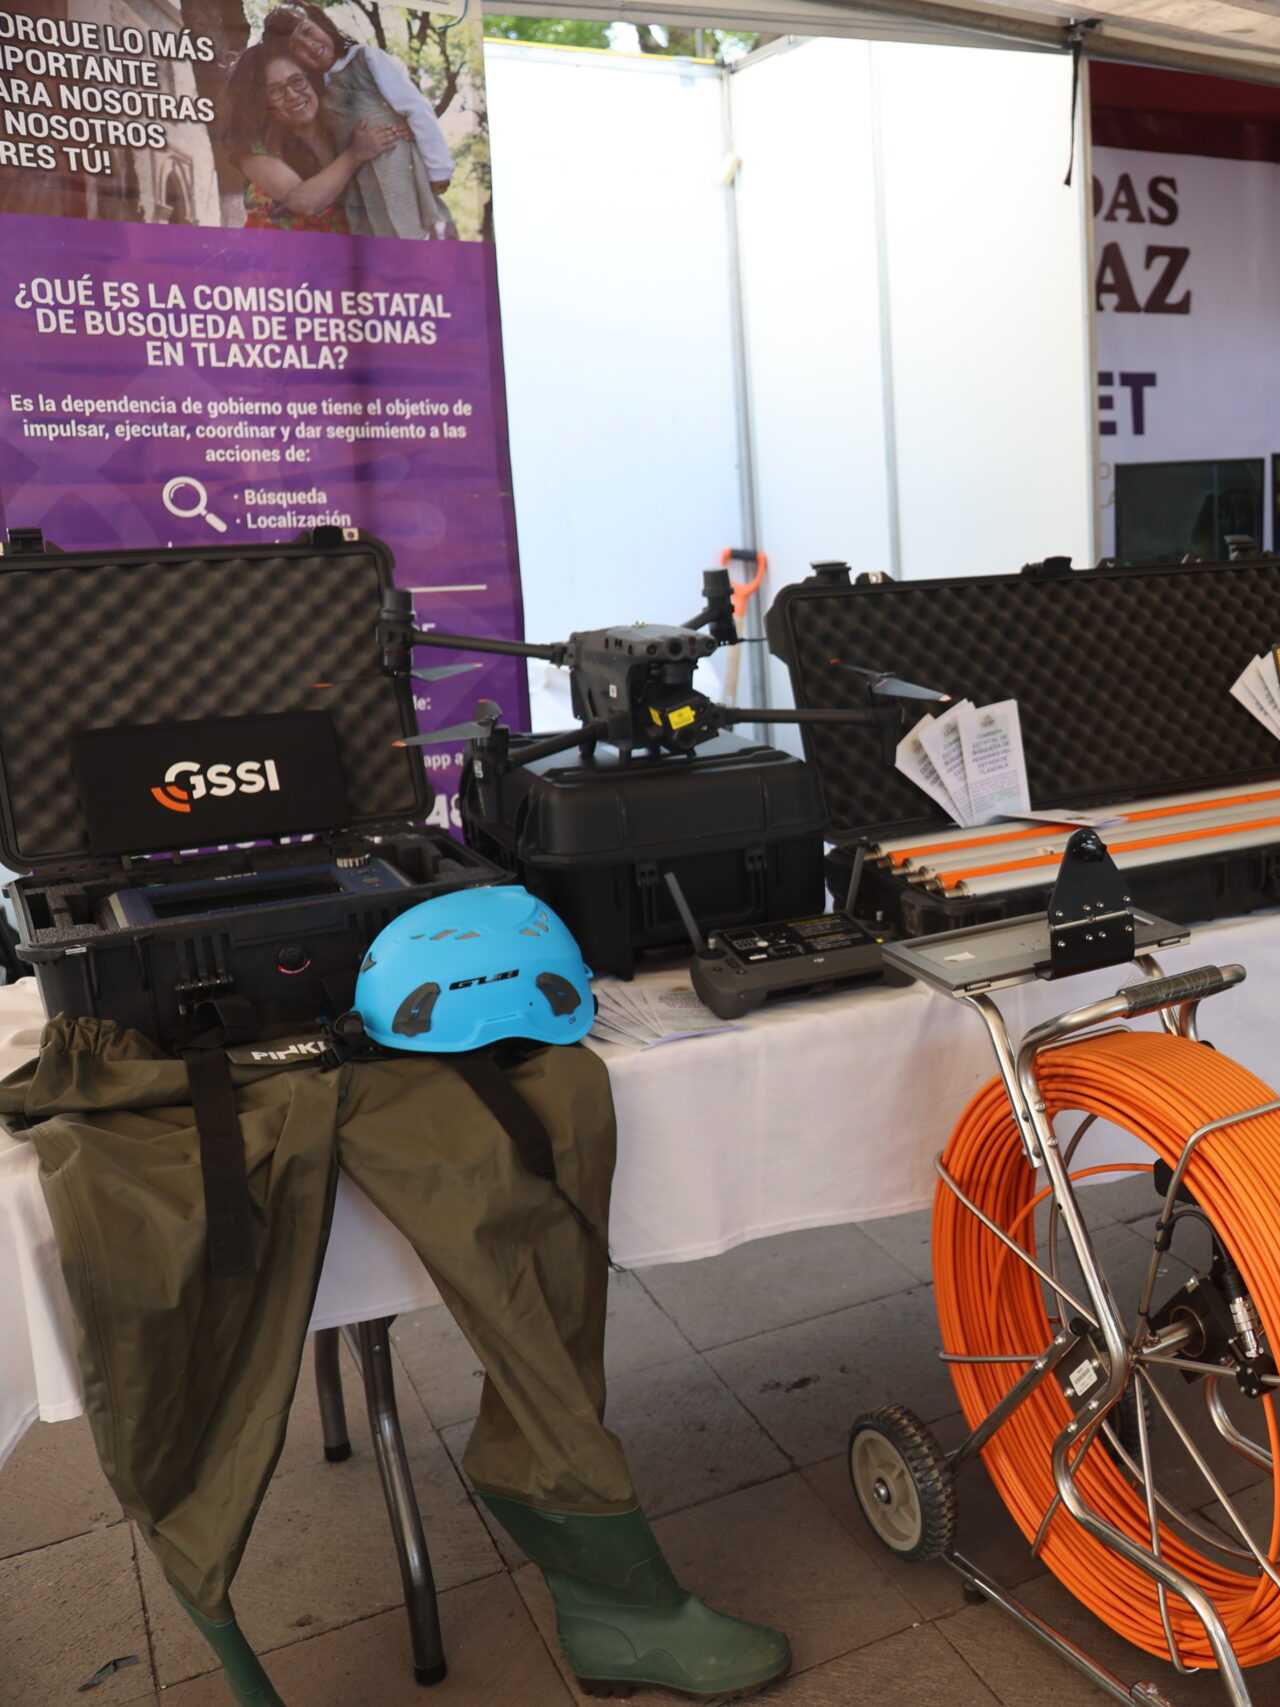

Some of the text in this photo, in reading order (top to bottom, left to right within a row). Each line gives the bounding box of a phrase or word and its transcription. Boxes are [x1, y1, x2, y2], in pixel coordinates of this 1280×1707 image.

[106, 25, 144, 54] LO
[151, 29, 215, 62] MÁS
[0, 45, 159, 88] PORTANTE
[59, 83, 215, 122] NOSOTRAS
[5, 109, 167, 149] NOSOTROS
[62, 143, 112, 175] TÚ!
[15, 273, 452, 319] ¿QUÉ ES LA COMISIÓN ESTATAL
[36, 304, 438, 346] DE BÚSQUEDA DE PERSONAS
[146, 340, 348, 370] EN TLAXCALA?
[10, 393, 473, 420] Es la dependencia de gobierno que tiene el objetivo de
[22, 419, 467, 442] impulsar, ejecutar, coordinar y dar seguimiento a las
[206, 445, 311, 462] acciones de:
[244, 487, 328, 509] Búsqueda
[246, 510, 351, 529] Localización
[152, 759, 280, 812] GSSI
